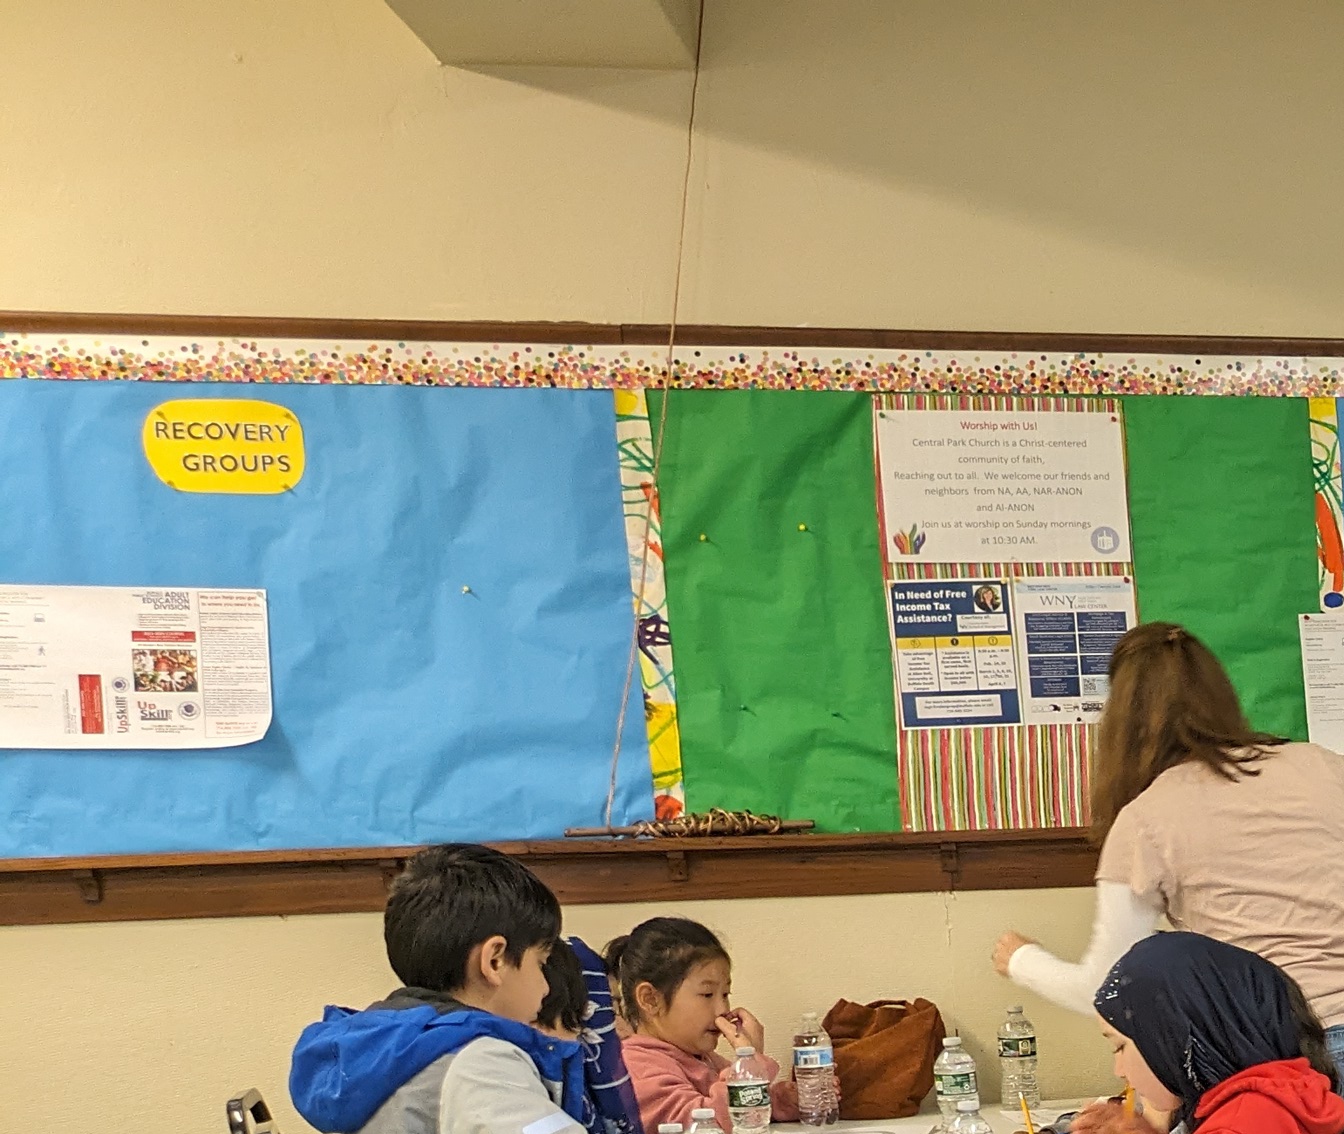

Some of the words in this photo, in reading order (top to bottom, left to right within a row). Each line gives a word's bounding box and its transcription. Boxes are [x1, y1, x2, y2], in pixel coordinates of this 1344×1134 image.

[960, 421, 998, 431] Worship
[1000, 421, 1020, 430] with
[1022, 422, 1037, 431] Us!
[155, 421, 290, 442] RECOVERY
[913, 438, 944, 447] Central
[947, 438, 966, 447] Park
[969, 438, 1000, 447] Church
[1003, 439, 1010, 447] is
[1020, 439, 1087, 447] Christ-centered
[182, 454, 291, 472] GROUPS
[958, 456, 1008, 465] community
[1011, 455, 1019, 464] of
[1021, 455, 1045, 465] faith,
[894, 472, 934, 481] Reaching
[966, 472, 979, 480] all.
[984, 472, 998, 480] We
[1001, 472, 1041, 480] welcome
[1061, 472, 1091, 481] friends
[1094, 472, 1109, 481] and
[925, 487, 969, 496] neighbors
[974, 487, 995, 495] from
[998, 488, 1013, 496] NA,
[1016, 488, 1031, 496] AA,
[976, 504, 992, 512] and
[922, 520, 939, 529] Join
[965, 520, 1000, 530] worship
[1016, 520, 1048, 530] Sunday
[1050, 520, 1091, 530] mornings
[993, 537, 1017, 545] 10:30
[1020, 537, 1037, 545] AM.
[895, 591, 904, 599] In
[907, 590, 931, 599] Need
[933, 590, 943, 598] of
[945, 590, 967, 598] Free
[896, 603, 931, 611] Income
[933, 602, 951, 610] Tax
[1040, 595, 1076, 609] WNY
[897, 614, 952, 623] Assistance?
[137, 701, 156, 710] Up
[140, 709, 168, 718] Skill
